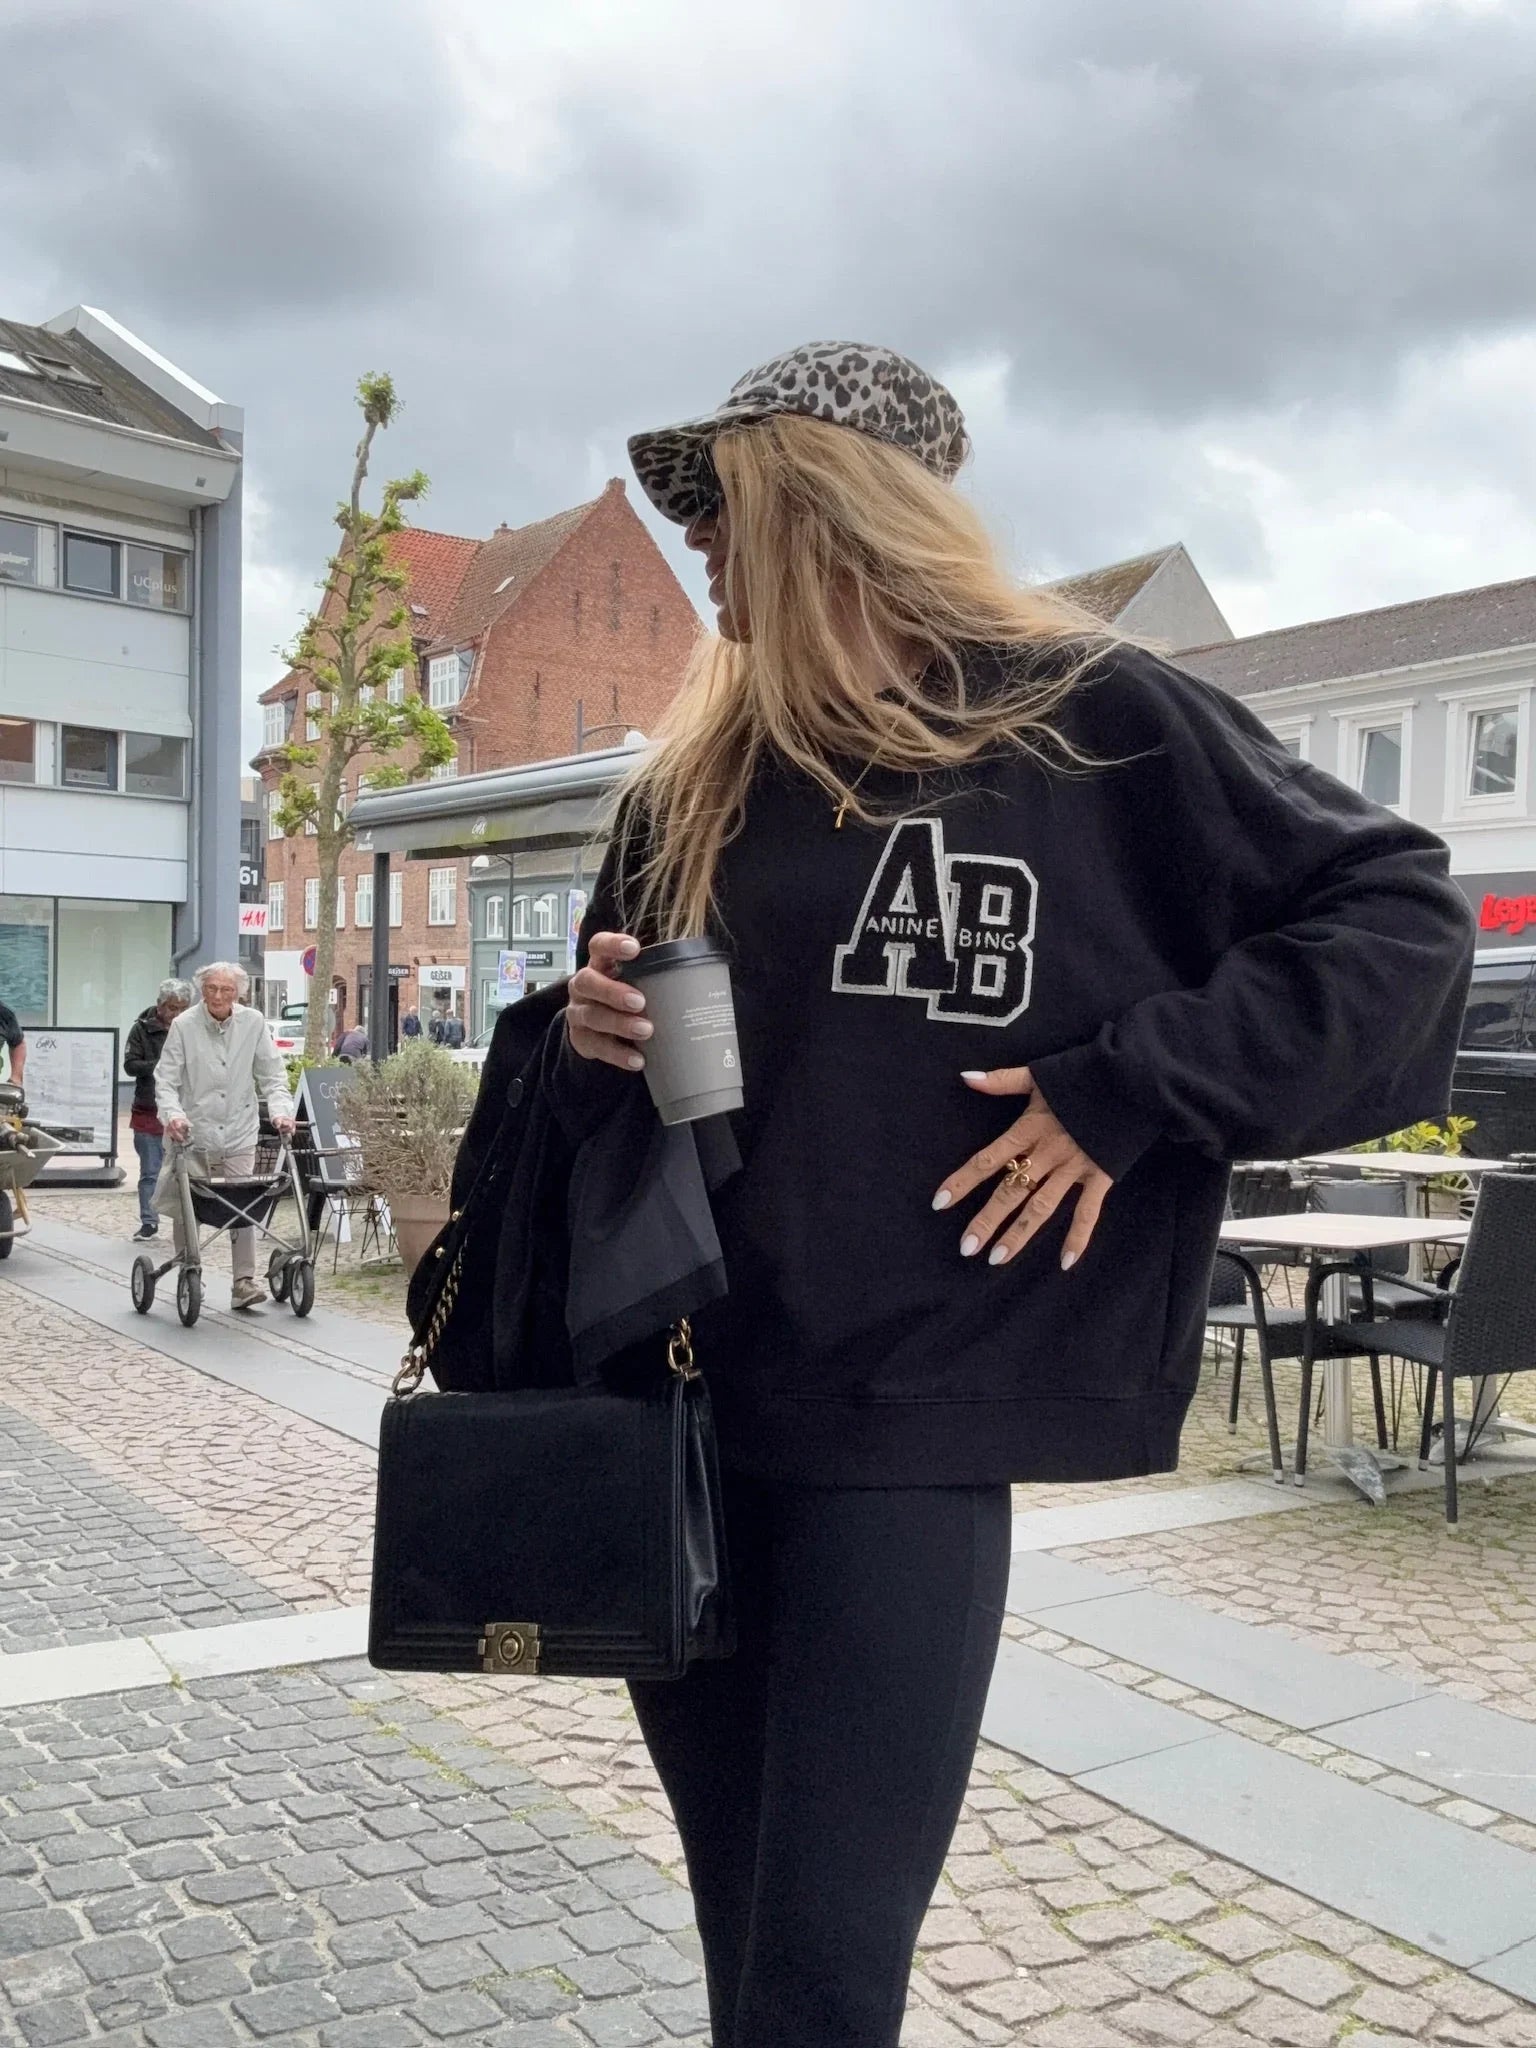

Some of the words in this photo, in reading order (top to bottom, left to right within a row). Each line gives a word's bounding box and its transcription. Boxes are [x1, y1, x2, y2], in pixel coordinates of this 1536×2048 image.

[133, 575, 178, 594] UCplus
[865, 916, 939, 938] ANINE
[958, 928, 1017, 951] BING
